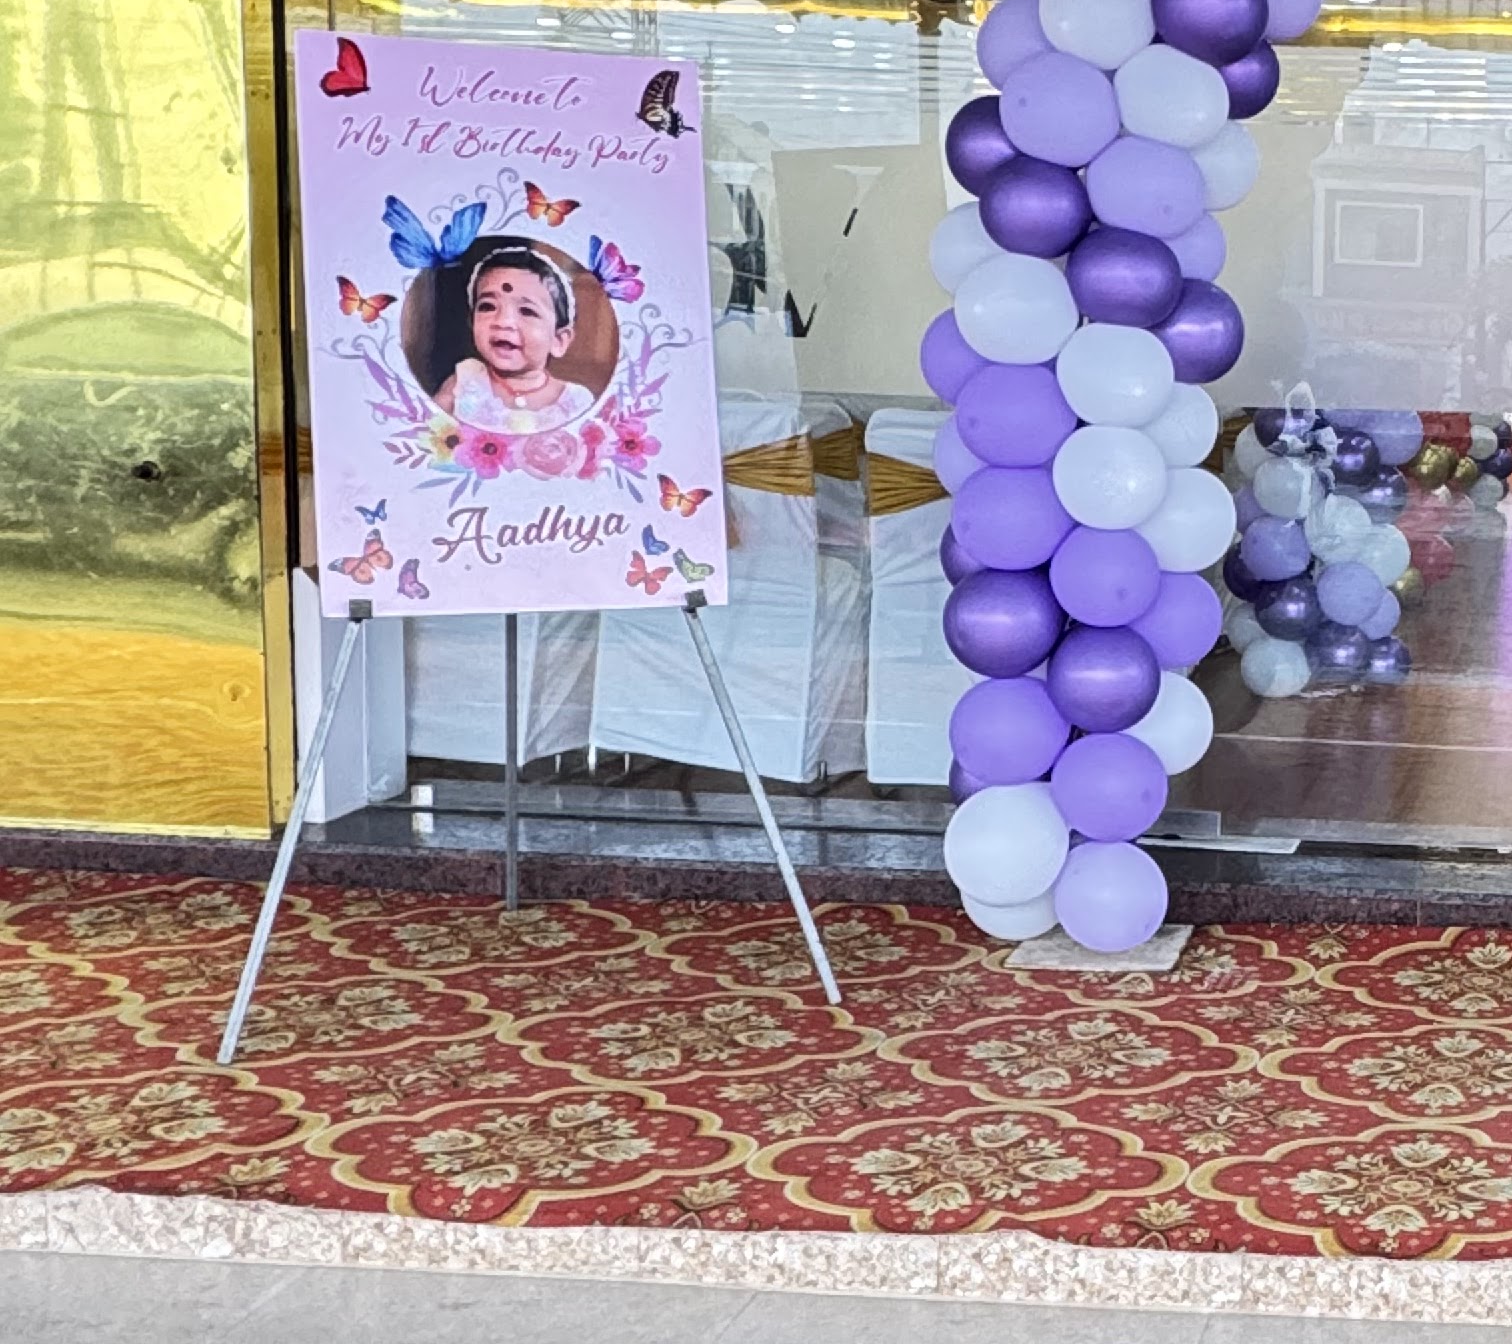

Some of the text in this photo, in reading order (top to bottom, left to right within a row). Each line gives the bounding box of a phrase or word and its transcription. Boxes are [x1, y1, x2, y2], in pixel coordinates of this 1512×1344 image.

[420, 66, 592, 111] Welcome to
[337, 115, 392, 156] My
[453, 126, 582, 170] Birthday
[588, 134, 670, 174] Party
[432, 504, 630, 565] Aadhya
